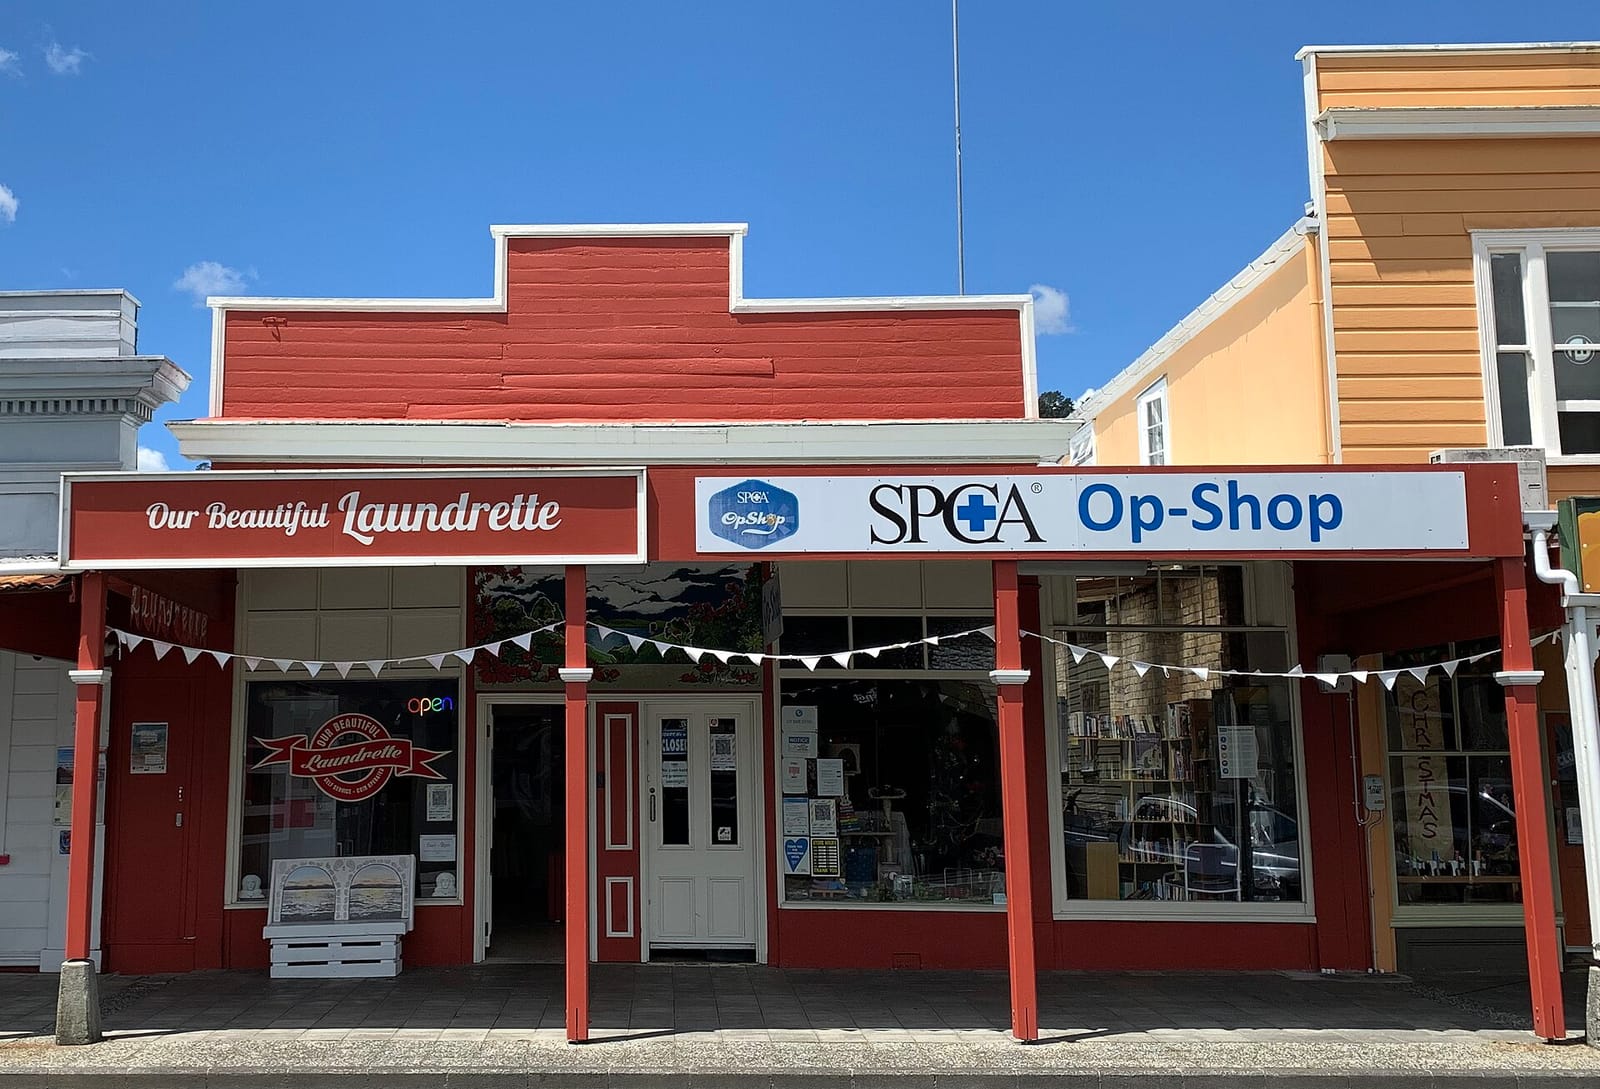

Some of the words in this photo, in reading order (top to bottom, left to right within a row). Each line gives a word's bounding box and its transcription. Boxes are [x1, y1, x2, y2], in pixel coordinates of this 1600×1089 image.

[146, 502, 199, 529] Our
[205, 501, 330, 537] Beautiful
[338, 491, 562, 546] Laundrette
[1078, 480, 1343, 543] Op-Shop
[407, 697, 454, 717] open
[316, 728, 334, 747] OUR
[332, 718, 381, 738] BEAUTIFUL
[662, 738, 687, 752] CLOSE
[300, 745, 402, 772] Laundrette
